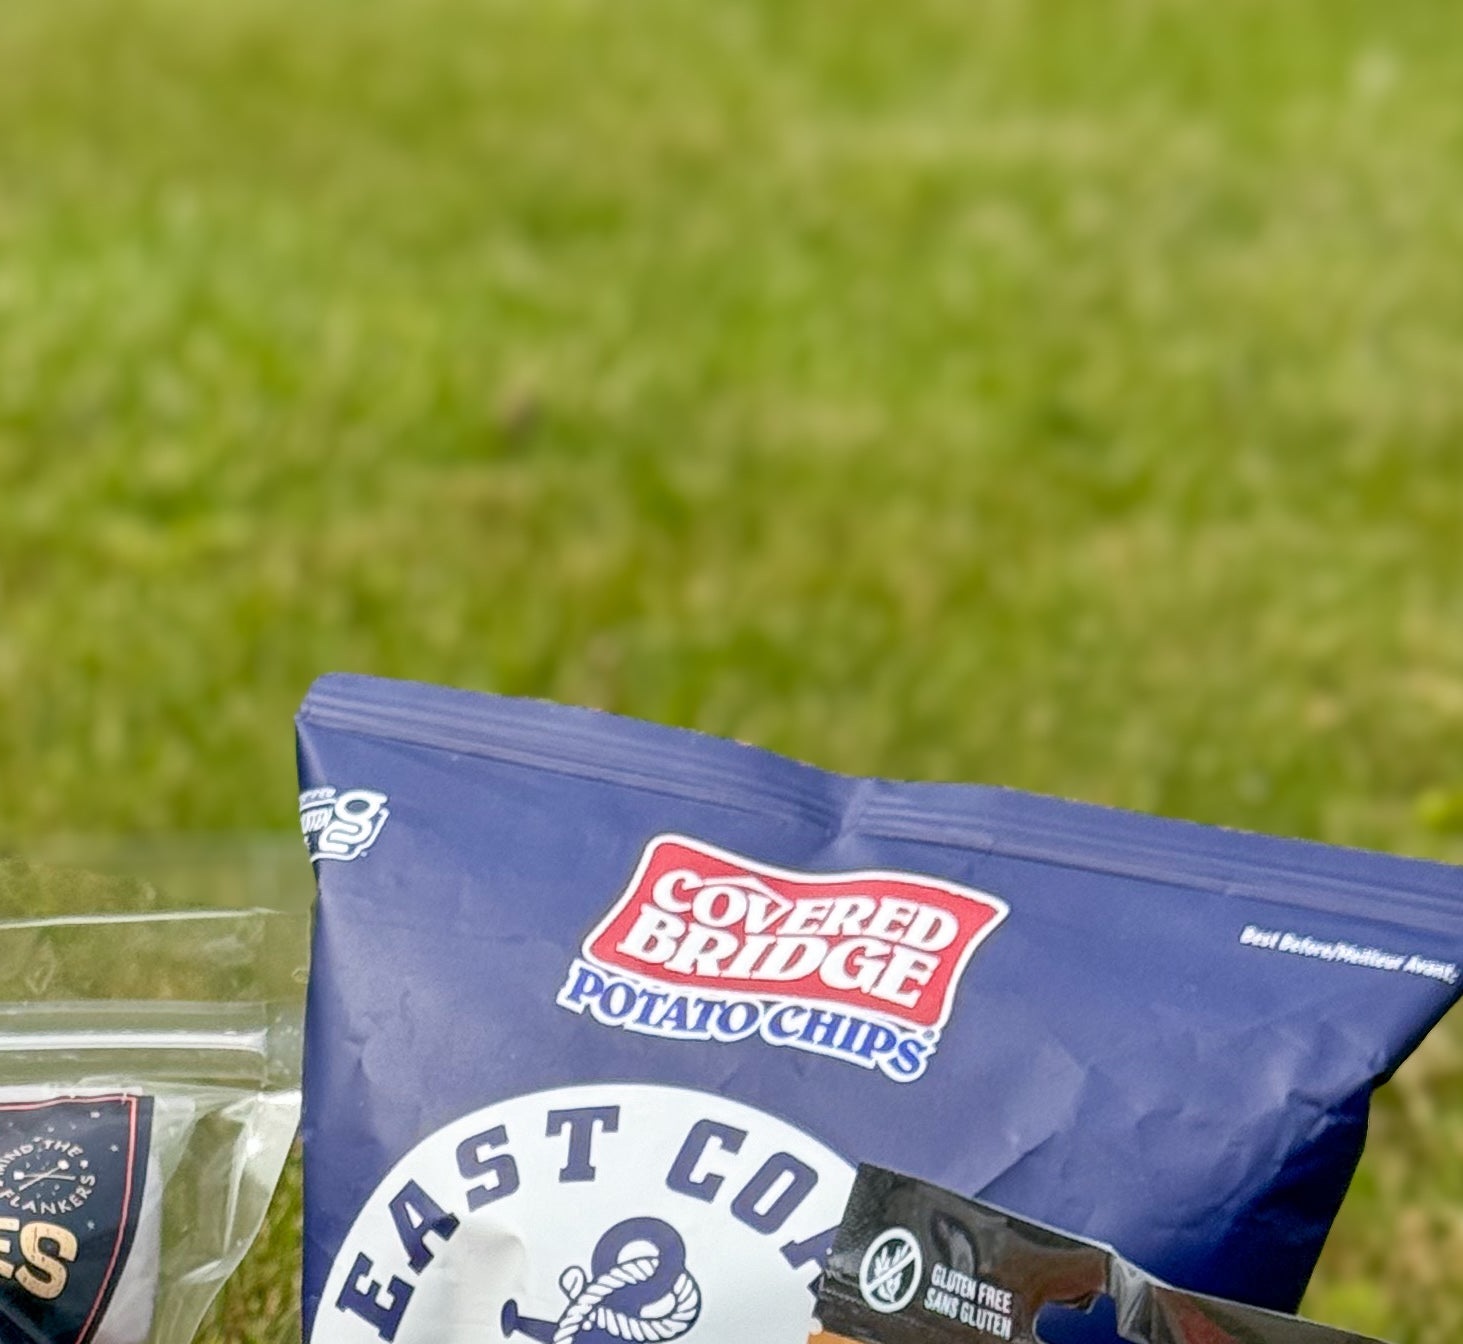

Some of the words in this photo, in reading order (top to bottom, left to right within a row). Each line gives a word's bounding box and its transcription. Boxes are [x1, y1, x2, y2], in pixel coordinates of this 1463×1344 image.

[652, 869, 959, 951] COVERED
[616, 904, 941, 1008] BRIDGE
[570, 968, 760, 1034] POTATO
[769, 1005, 924, 1075] CHIPS
[43, 1138, 84, 1159] THE
[1, 1174, 96, 1215] FLANKERS
[335, 1105, 621, 1342] EAST
[924, 1288, 960, 1319] SANS
[960, 1303, 1013, 1341] GLUTEN
[931, 1263, 977, 1301] GLUTEN
[978, 1282, 1013, 1315] FREE
